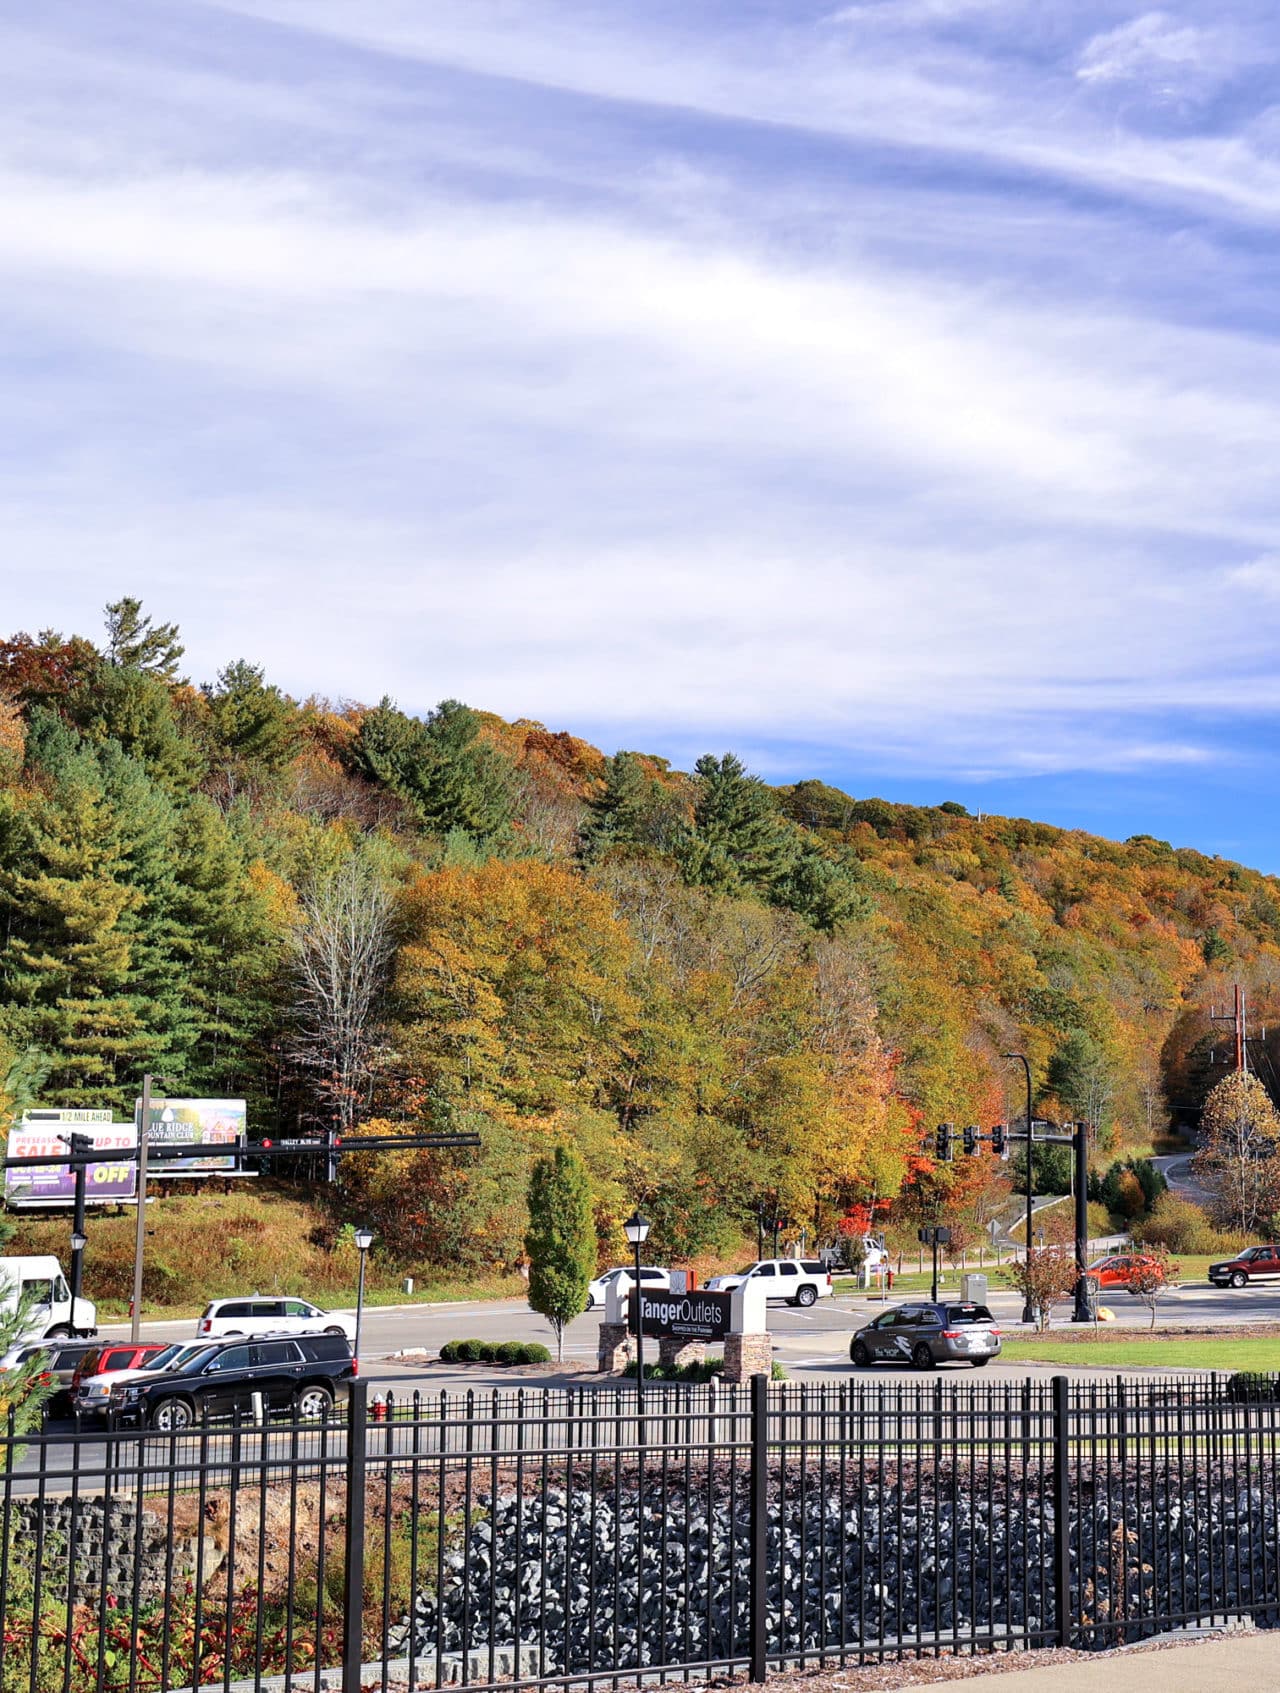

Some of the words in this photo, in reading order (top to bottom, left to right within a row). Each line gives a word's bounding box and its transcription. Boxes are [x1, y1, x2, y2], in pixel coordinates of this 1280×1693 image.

[62, 1112, 72, 1121] 1/2
[74, 1112, 90, 1122] MILE
[91, 1112, 111, 1122] AHEAD
[166, 1122, 194, 1132] RIDGE
[146, 1131, 175, 1139] OUNTAIN
[95, 1137, 112, 1147] UP
[115, 1137, 130, 1147] TO
[93, 1166, 129, 1183] OFF
